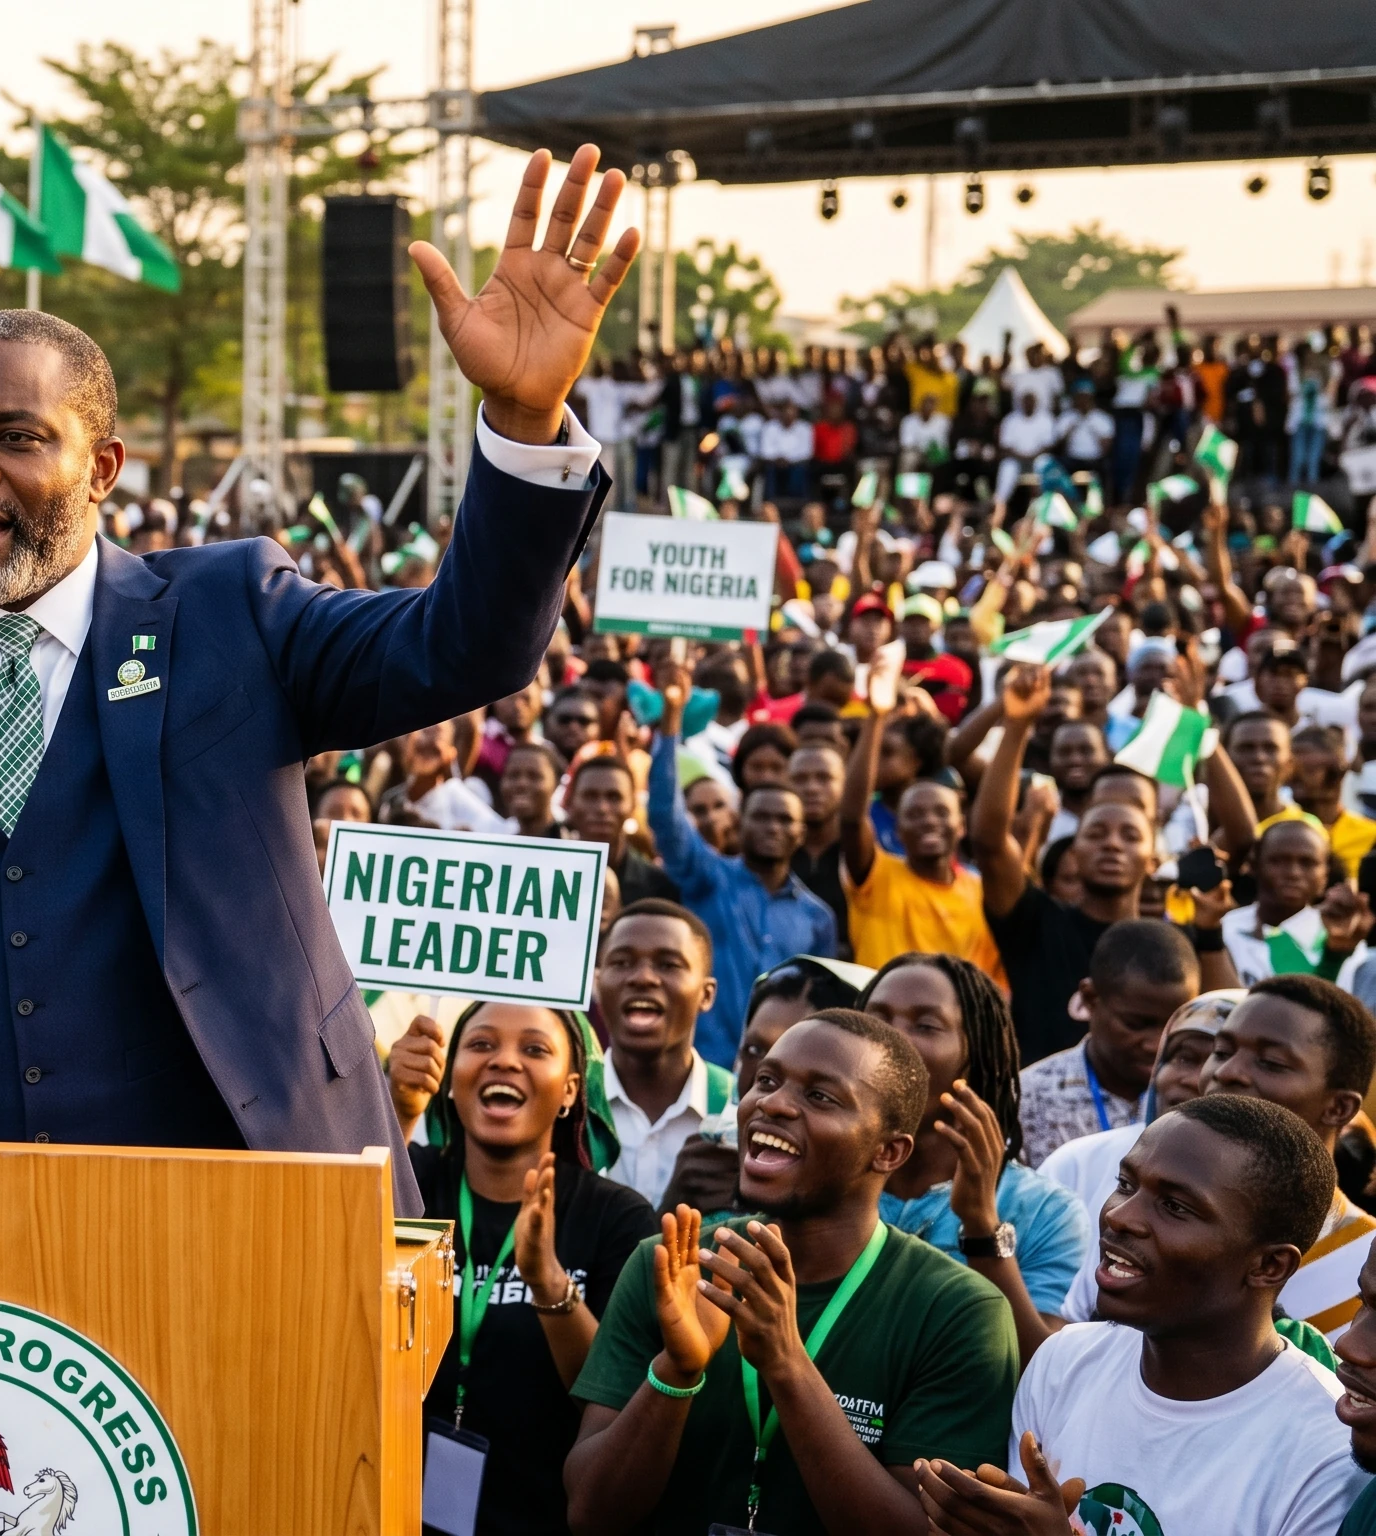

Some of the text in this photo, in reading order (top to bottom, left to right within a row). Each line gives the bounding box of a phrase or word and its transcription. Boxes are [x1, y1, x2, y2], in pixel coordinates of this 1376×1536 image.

[648, 541, 727, 569] YOUTH
[610, 566, 758, 599] FOR NIGERIA
[343, 850, 583, 922] NIGERIAN
[360, 915, 548, 983] LEADER
